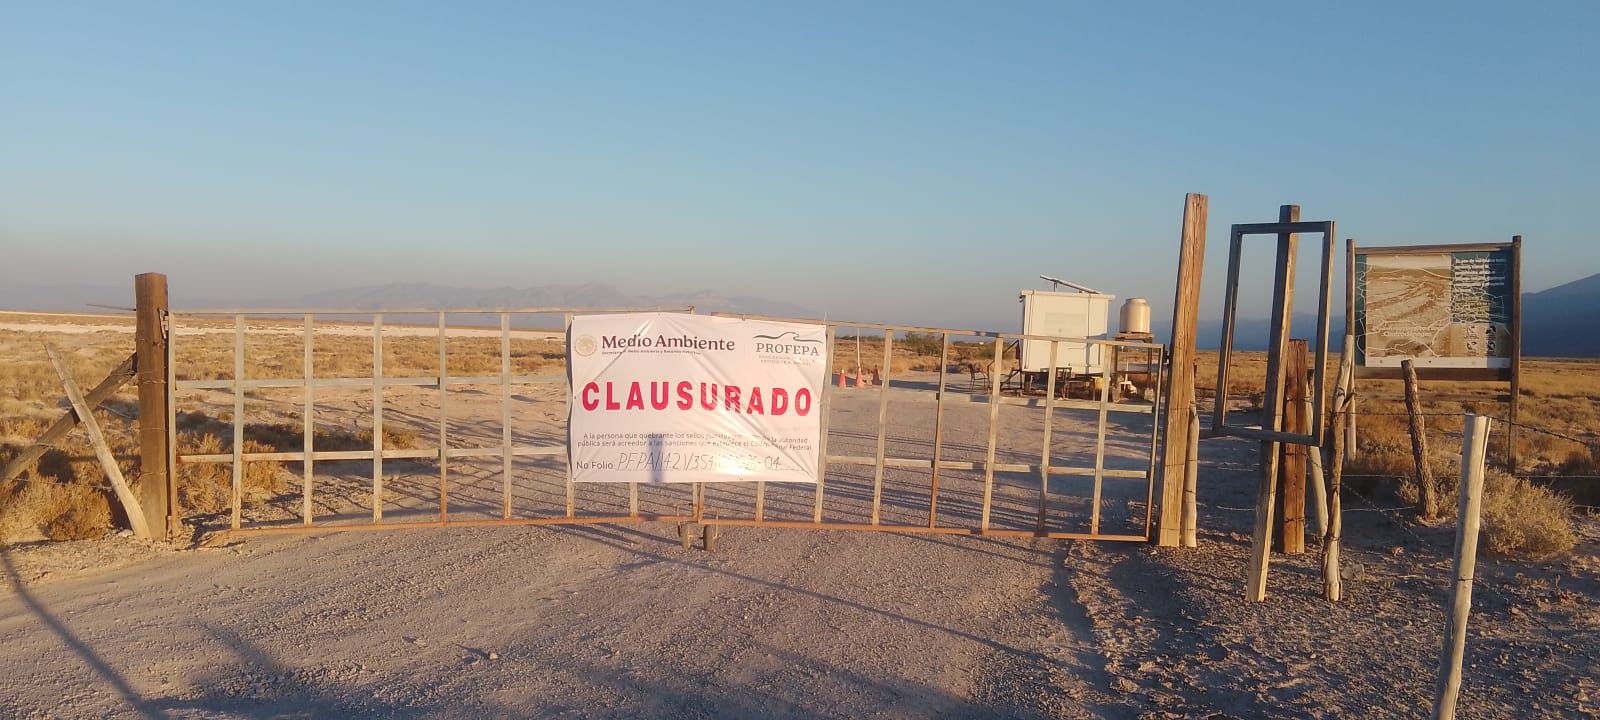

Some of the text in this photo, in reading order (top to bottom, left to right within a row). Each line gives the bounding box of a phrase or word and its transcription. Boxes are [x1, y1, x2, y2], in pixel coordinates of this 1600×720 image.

[601, 334, 735, 351] Medio Ambiente
[756, 342, 819, 356] PROFEPA
[582, 381, 812, 416] CLAUSURADO
[639, 432, 674, 440] quebrante
[577, 440, 601, 448] pública
[617, 439, 647, 447] acreedor
[576, 461, 614, 470] No Folio
